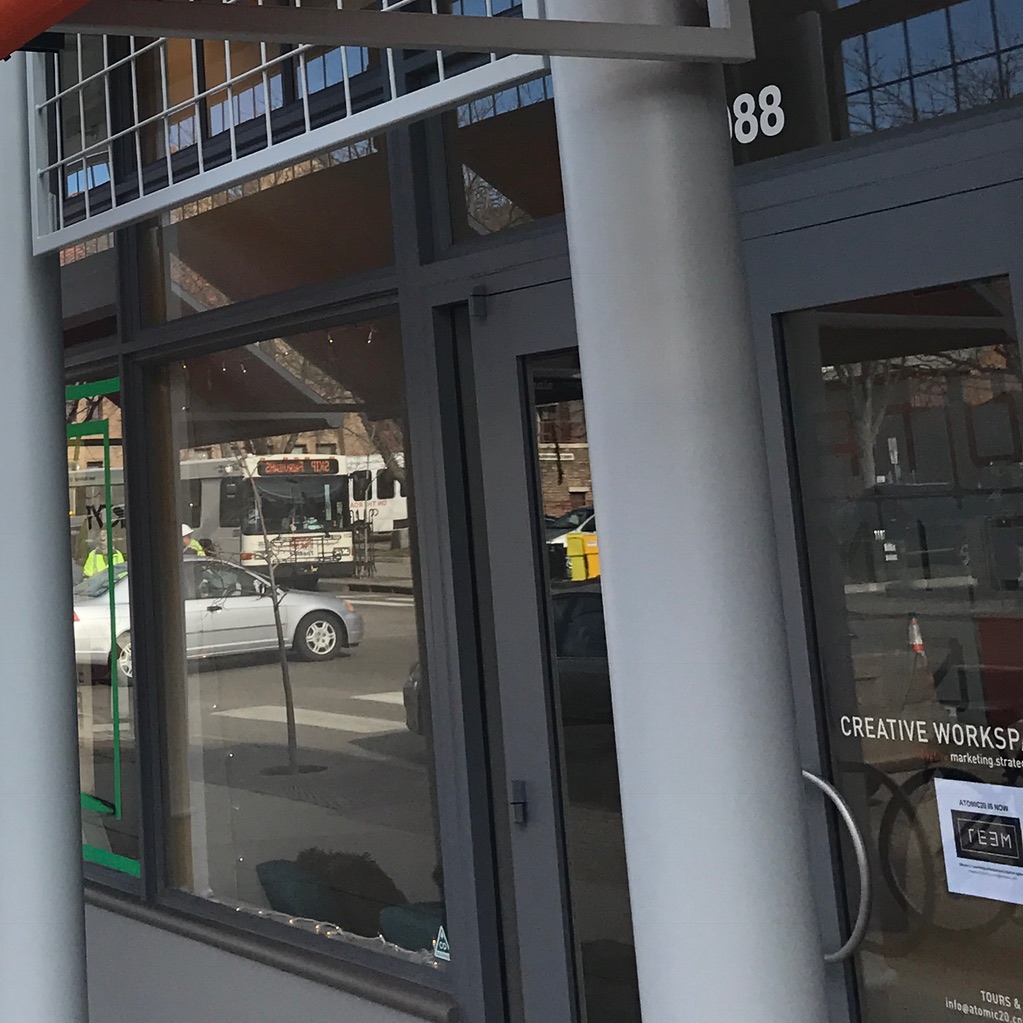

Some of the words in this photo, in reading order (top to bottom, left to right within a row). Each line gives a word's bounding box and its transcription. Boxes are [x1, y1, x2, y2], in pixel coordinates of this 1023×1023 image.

[726, 84, 785, 144] 88
[840, 714, 929, 743] CREATIVE
[933, 721, 1023, 751] WORKSP
[994, 804, 1009, 812] NOW
[980, 990, 1012, 1008] TOURS
[1013, 998, 1021, 1010] &
